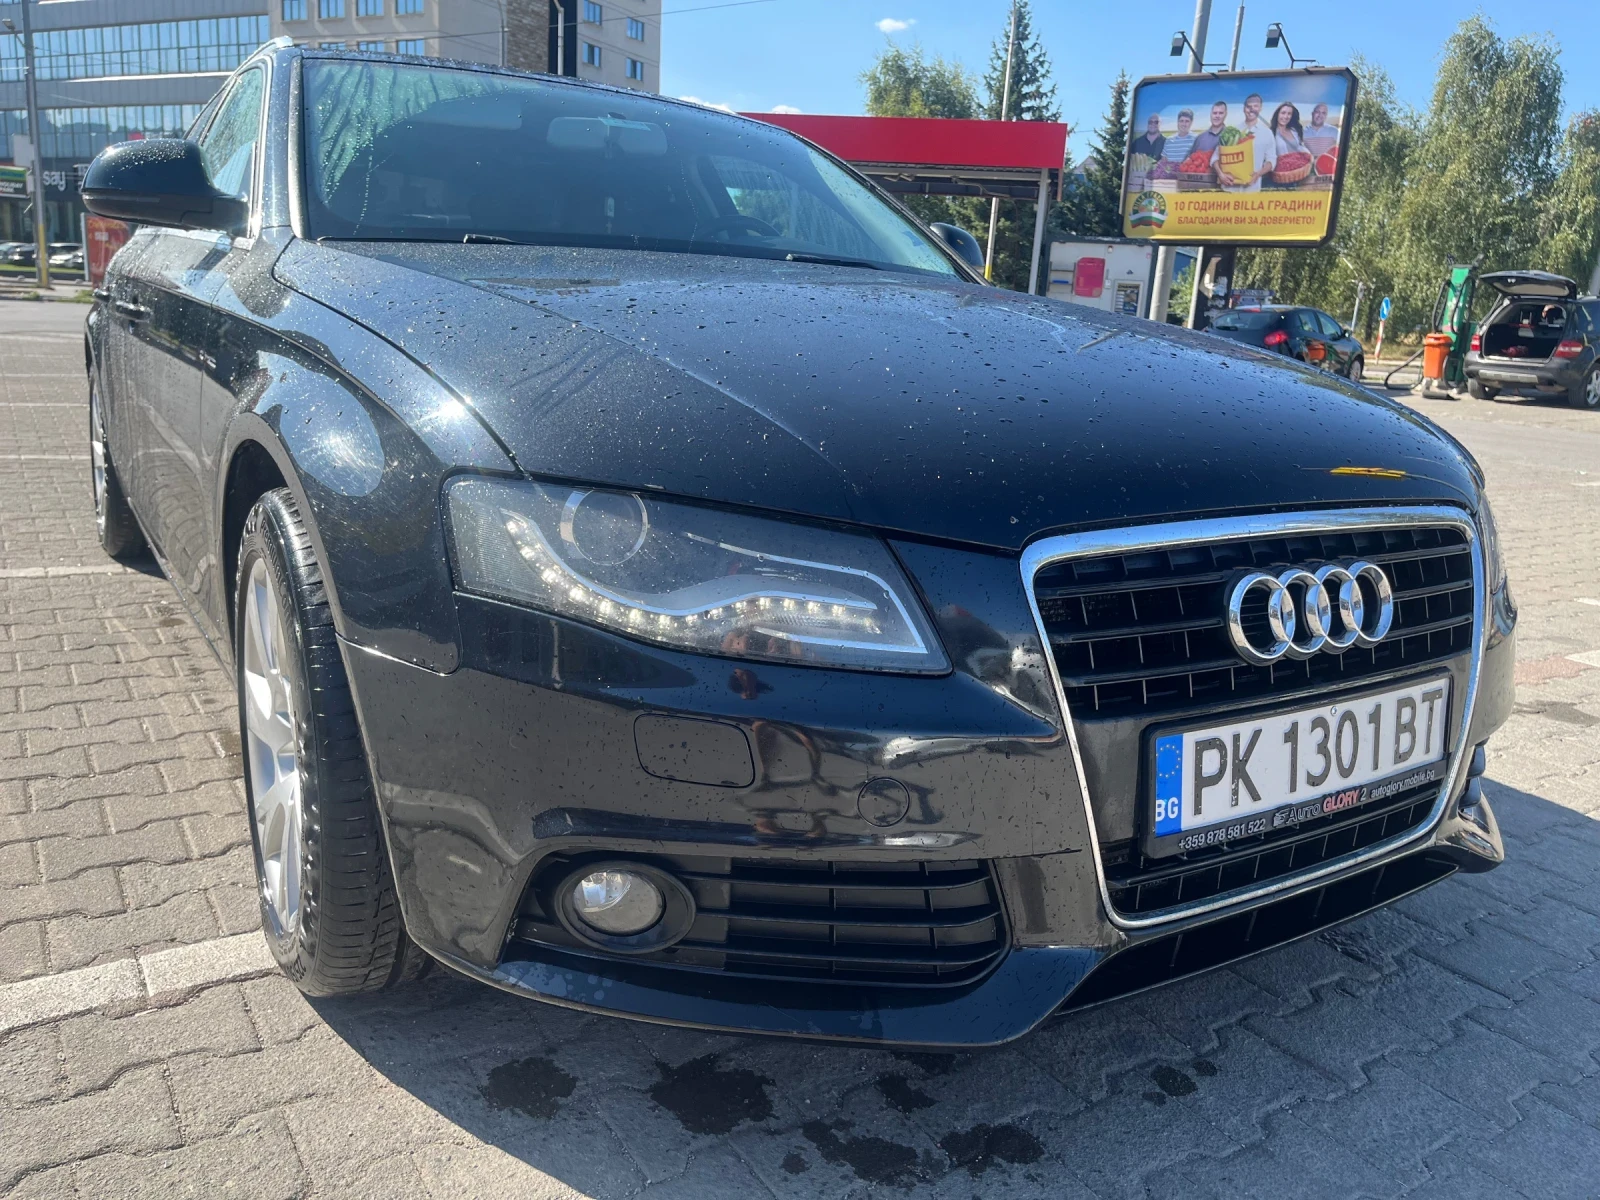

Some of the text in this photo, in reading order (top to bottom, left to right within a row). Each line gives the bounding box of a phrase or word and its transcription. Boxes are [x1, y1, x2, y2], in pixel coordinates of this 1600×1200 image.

[1221, 153, 1243, 163] BILLA
[43, 170, 66, 192] say
[1174, 200, 1323, 212] 10 ГОДИНИ BILLA ГРАДИНИ
[1177, 216, 1316, 226] БЛАГОДАРИМ ВИ ЗА ДОВЕРИЕТО!
[1194, 688, 1443, 816] PK 1301 BT
[1156, 797, 1179, 822] BG
[1178, 833, 1205, 849] +359
[1206, 828, 1226, 844] 878
[1227, 823, 1246, 839] 581
[1247, 818, 1266, 834] 522
[1323, 788, 1360, 813] GLORY
[1360, 787, 1367, 801] 2
[1370, 769, 1435, 798] autoglory.mobile.bg
